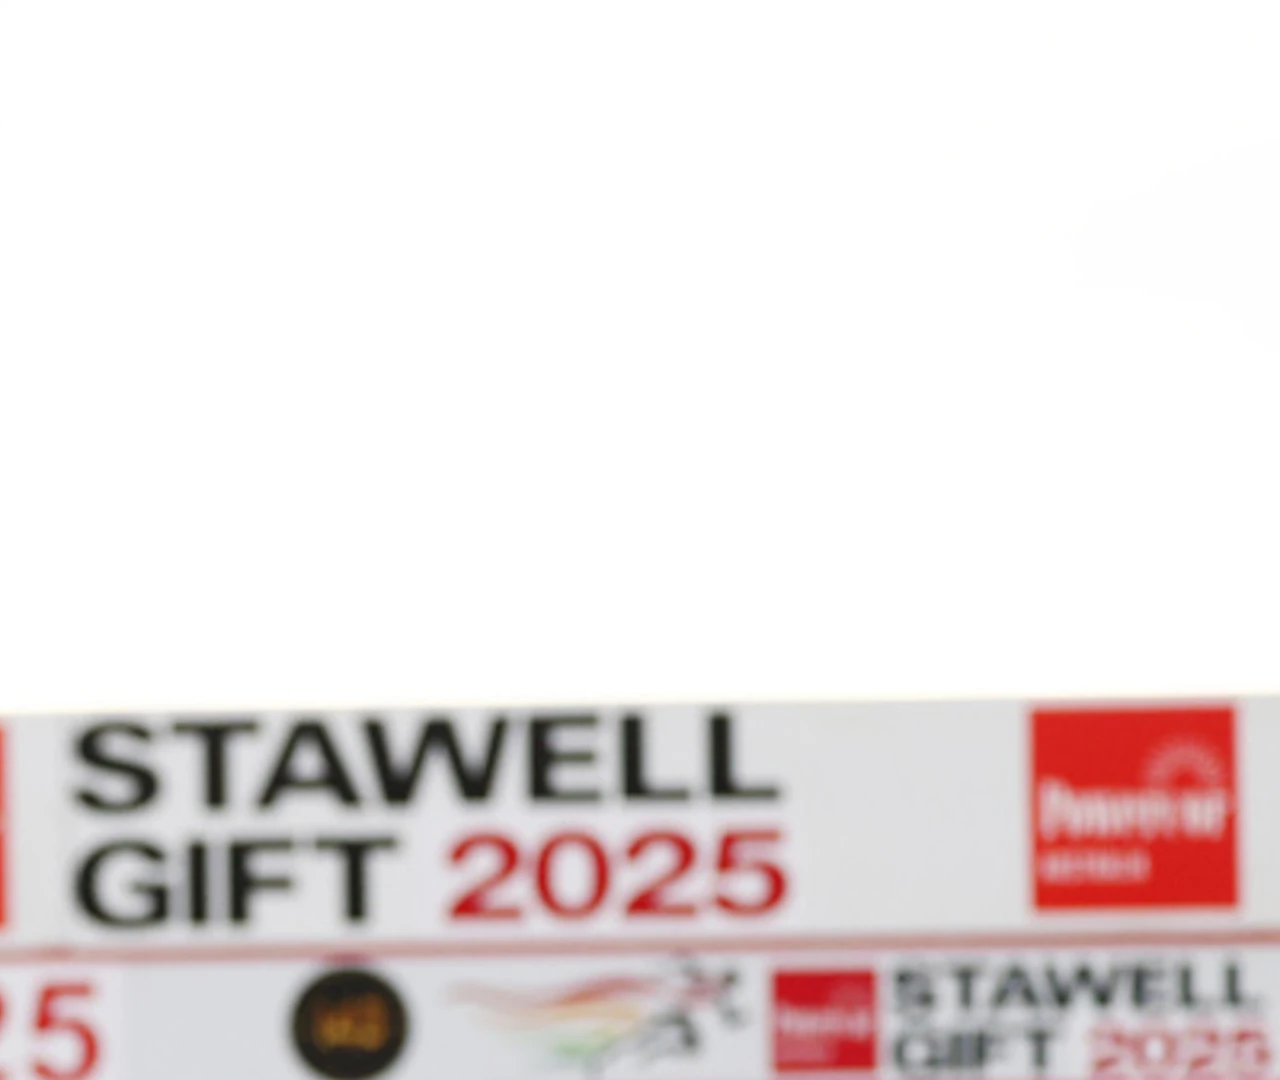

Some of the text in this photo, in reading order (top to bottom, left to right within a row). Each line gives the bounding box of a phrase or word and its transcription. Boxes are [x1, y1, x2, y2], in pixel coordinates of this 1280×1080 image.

[73, 711, 780, 814] STAWELL
[72, 830, 789, 929] GIFT 2025
[891, 959, 1249, 1014] STAWELL
[889, 1026, 1272, 1080] GIFT 2025
